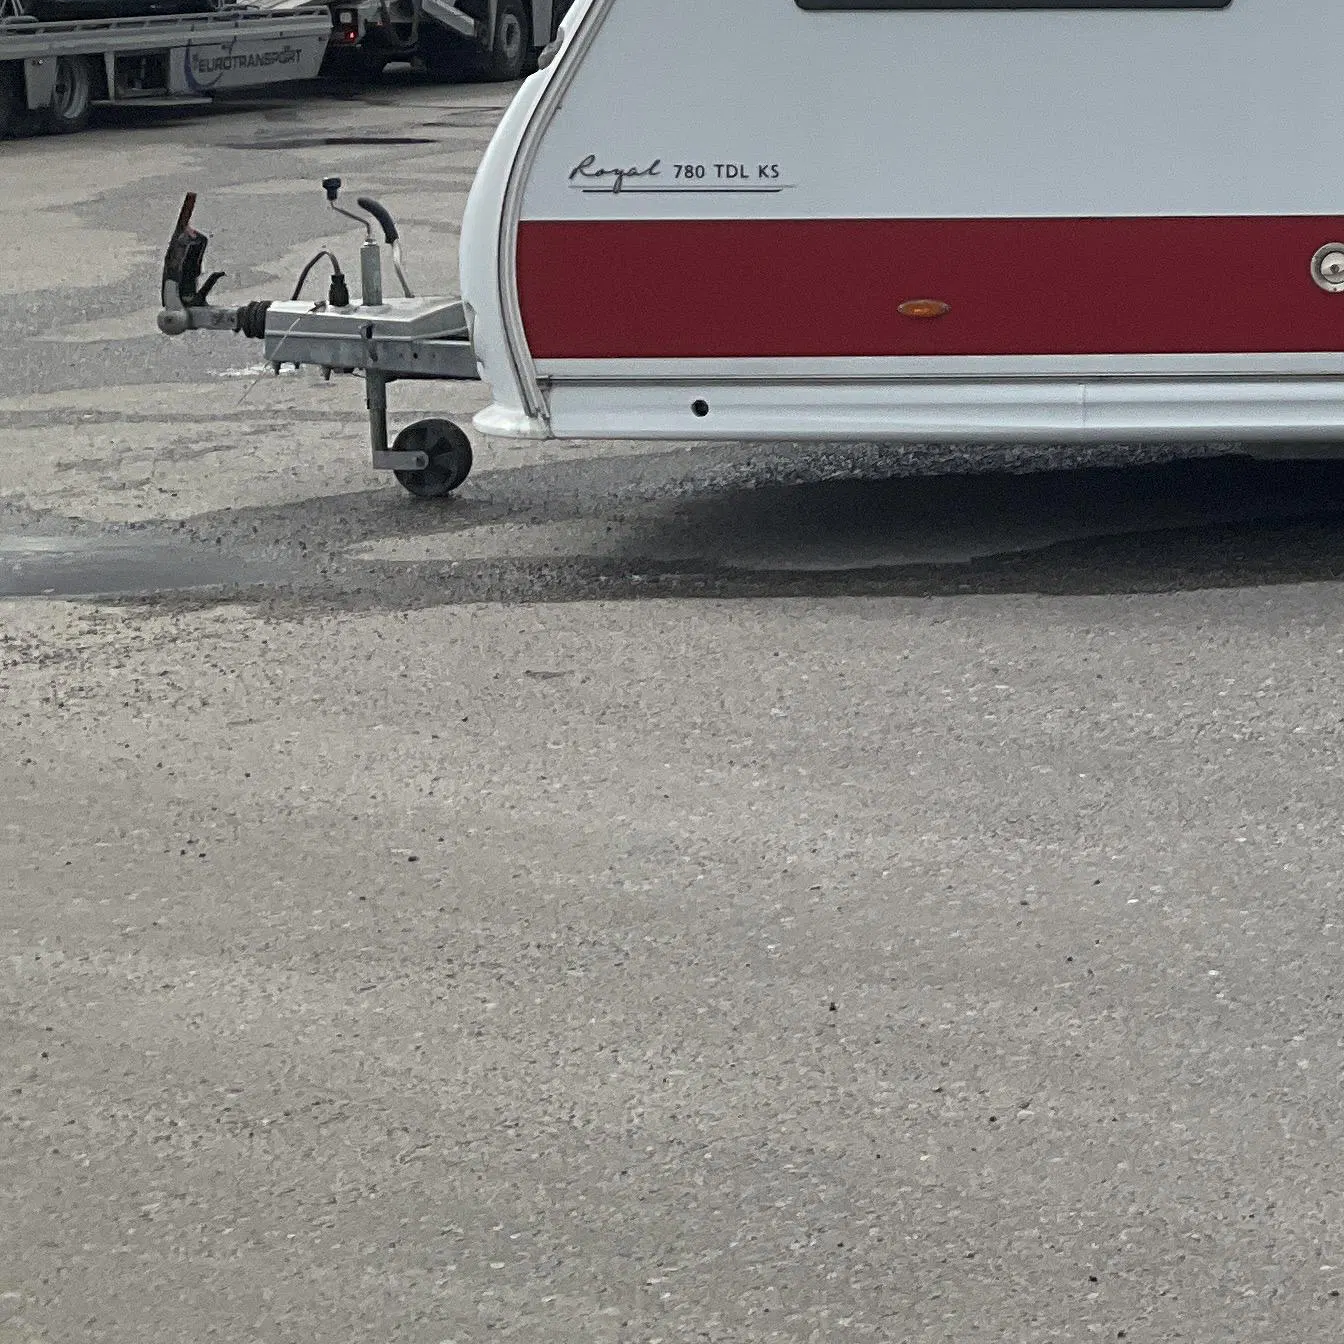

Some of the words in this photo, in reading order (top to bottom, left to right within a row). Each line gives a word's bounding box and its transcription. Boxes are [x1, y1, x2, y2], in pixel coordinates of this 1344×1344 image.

[568, 154, 661, 194] Royal
[673, 164, 705, 179] 780
[713, 164, 749, 179] TDL
[758, 164, 780, 179] KS
